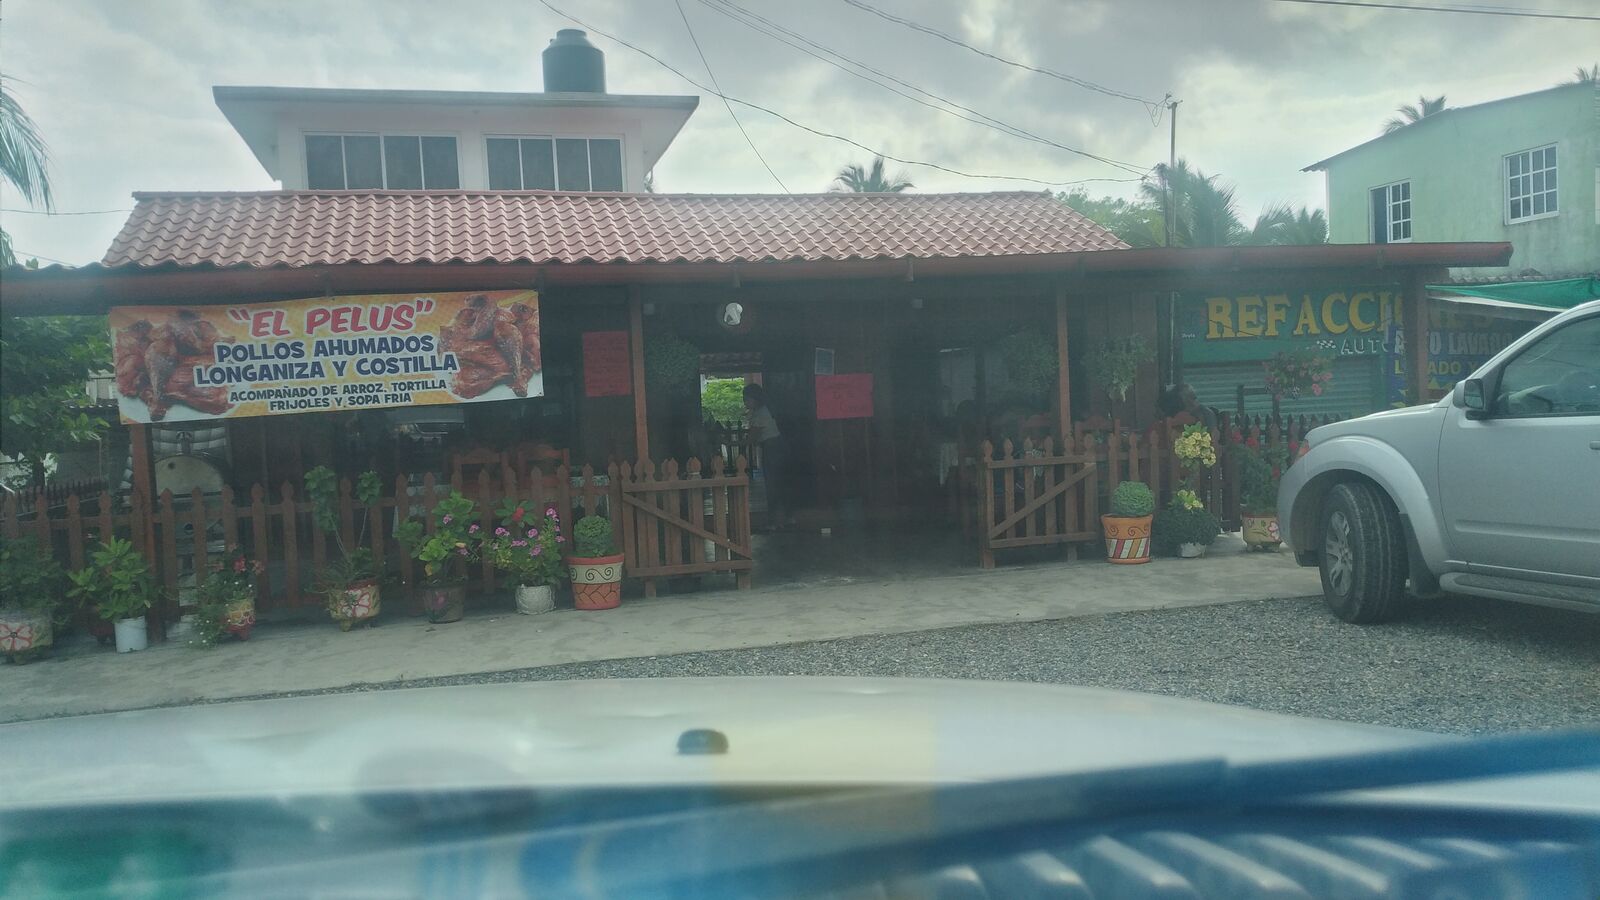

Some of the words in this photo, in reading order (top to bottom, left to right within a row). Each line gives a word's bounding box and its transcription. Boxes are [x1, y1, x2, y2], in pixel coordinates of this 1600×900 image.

[216, 341, 304, 363] POLLOS
[314, 335, 434, 357] AHUMADOS
[196, 360, 325, 385] LONGANIZA
[332, 360, 347, 377] Y
[356, 354, 457, 375] COSTILLA
[230, 385, 318, 401] ACOMPAÑADO
[322, 385, 338, 397] DE
[391, 379, 447, 392] TORTILLA
[270, 397, 330, 411] FRIJOLES
[333, 397, 343, 407] Y
[350, 394, 380, 406] SOPA
[384, 392, 412, 404] FRIA
